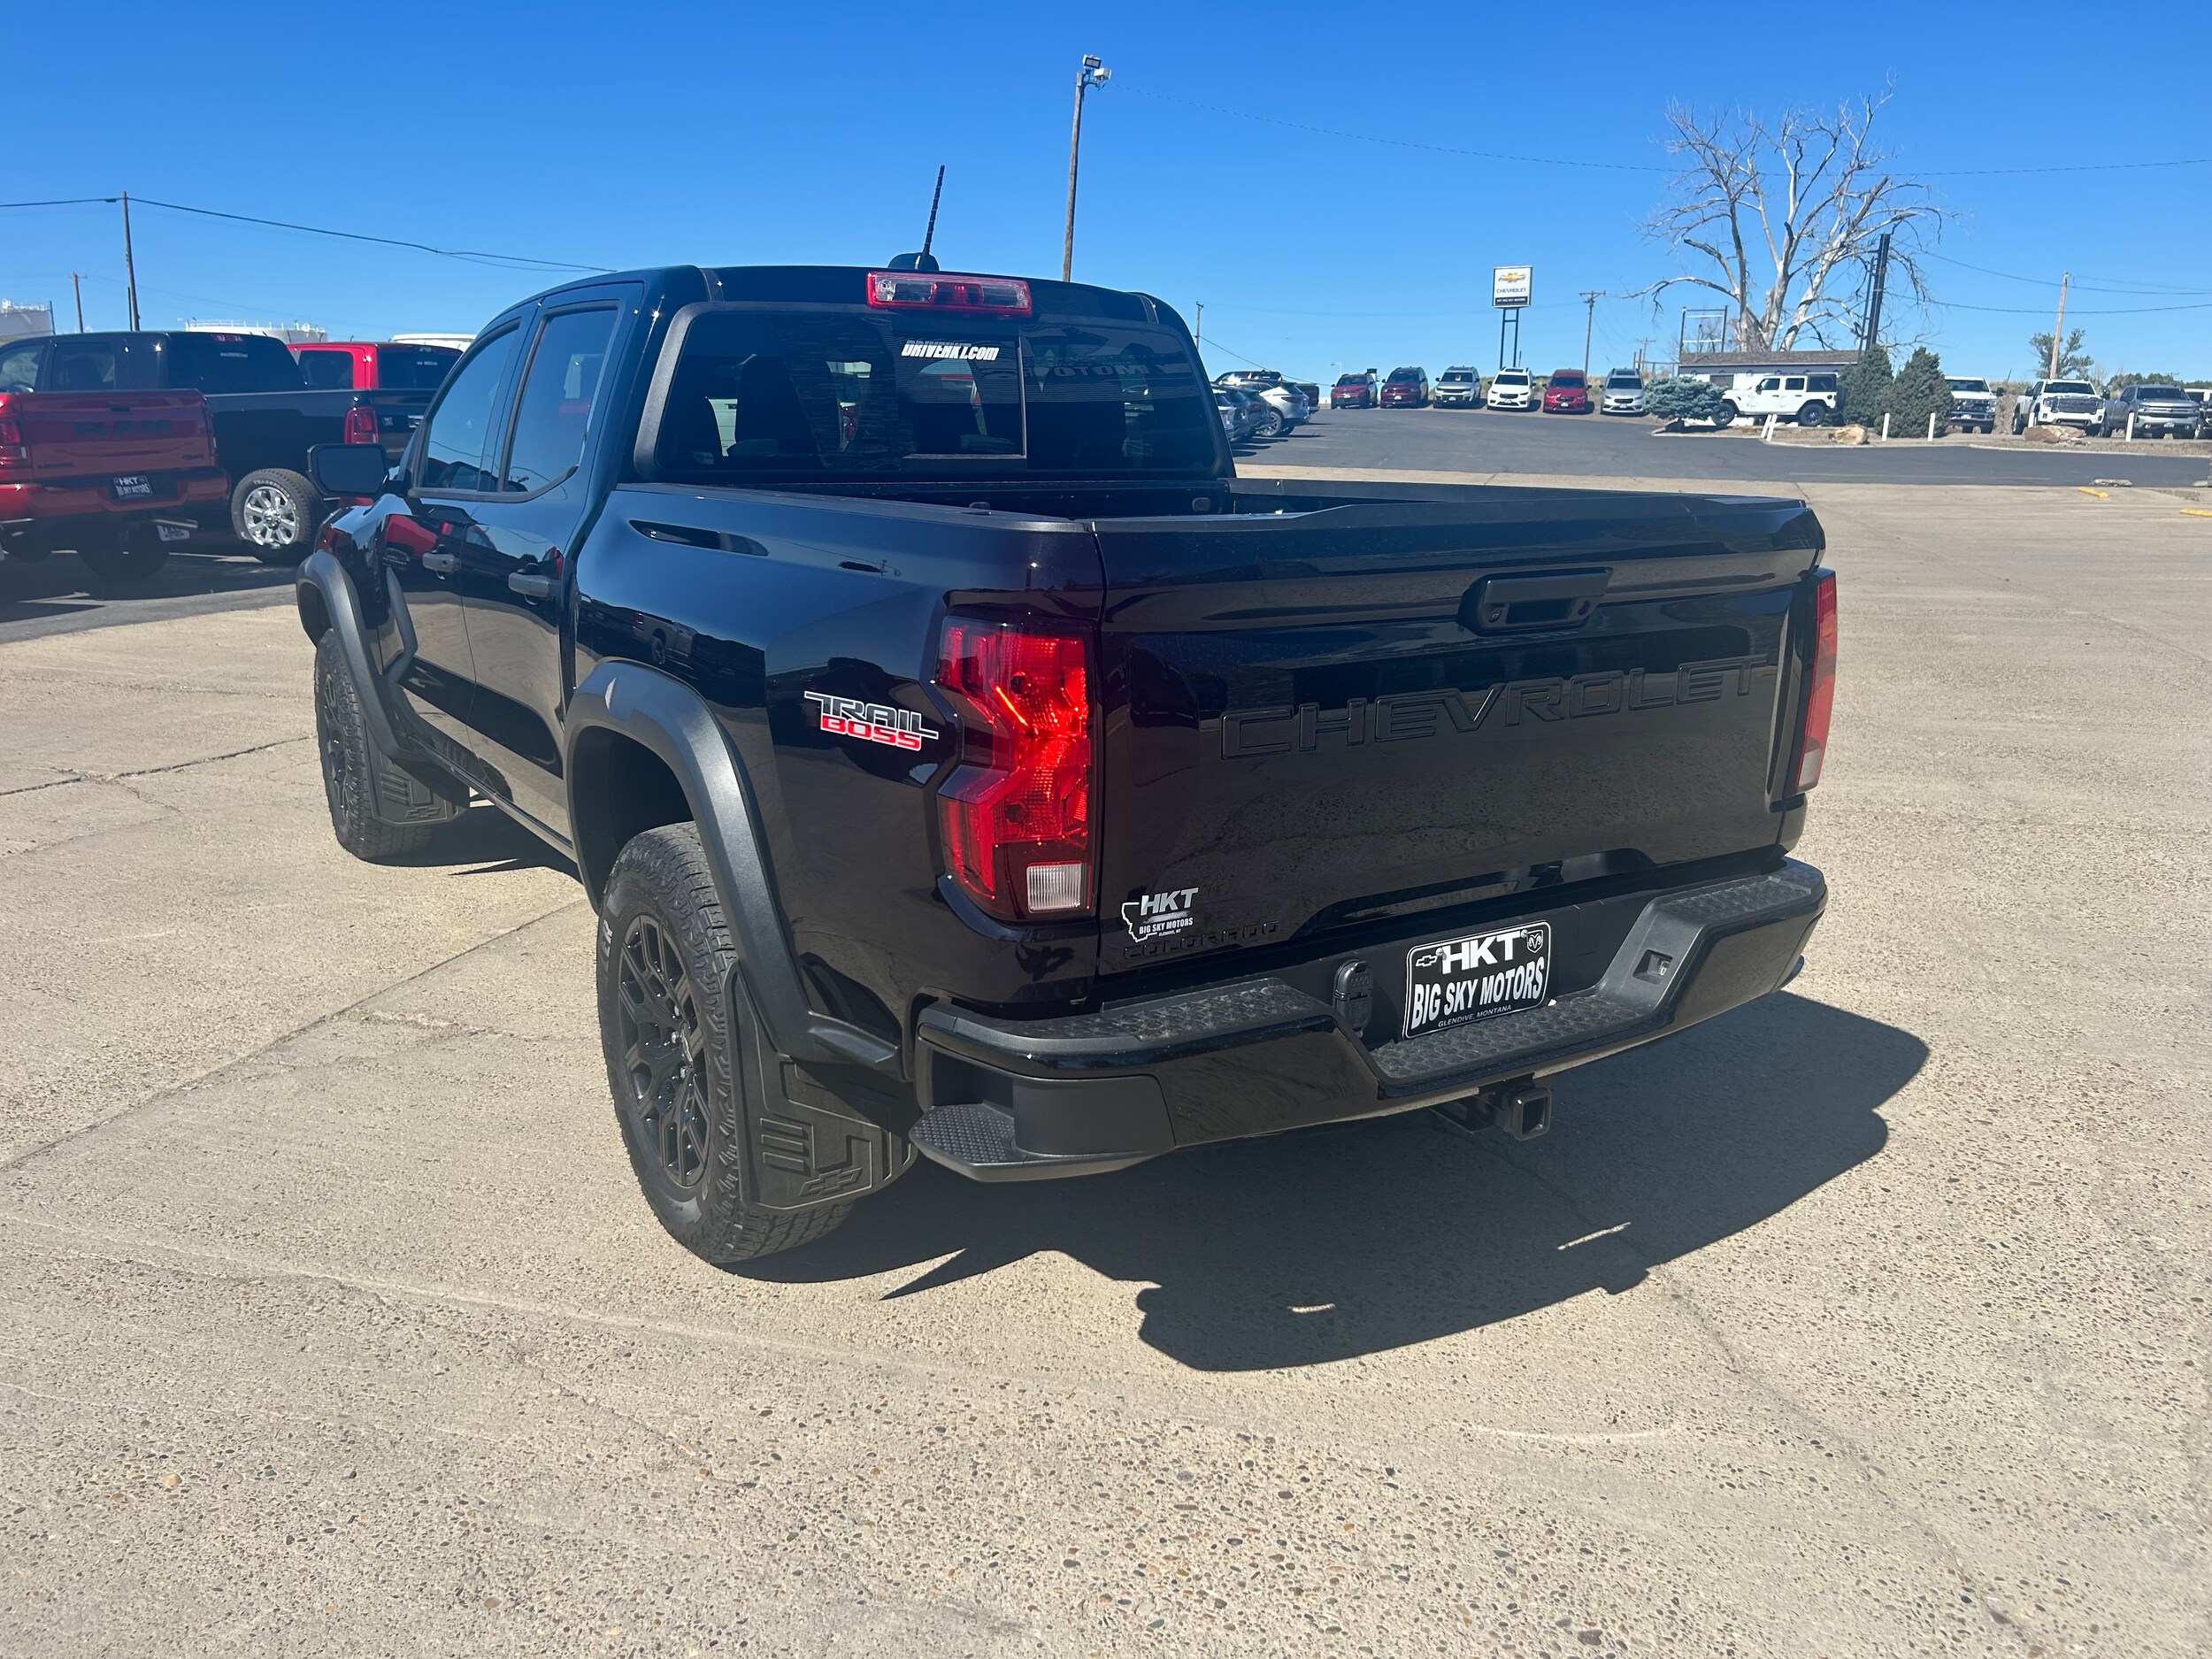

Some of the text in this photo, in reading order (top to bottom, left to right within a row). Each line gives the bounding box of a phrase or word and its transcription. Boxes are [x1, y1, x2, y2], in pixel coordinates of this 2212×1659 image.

[119, 476, 139, 486] HKT
[803, 690, 939, 740] TRAIL
[1221, 654, 1768, 760] CHEVROLET
[820, 714, 923, 752] BOSS
[1141, 887, 1199, 916] HKT
[1124, 920, 1280, 959] COLORADO
[1139, 917, 1194, 935] BIG SKY MOTORS
[1442, 930, 1520, 974] HKT
[1410, 983, 1441, 1029] BIG
[1443, 979, 1479, 1016] SKY
[1479, 956, 1545, 1005] MOTORS
[1476, 1004, 1512, 1018] MONTANA
